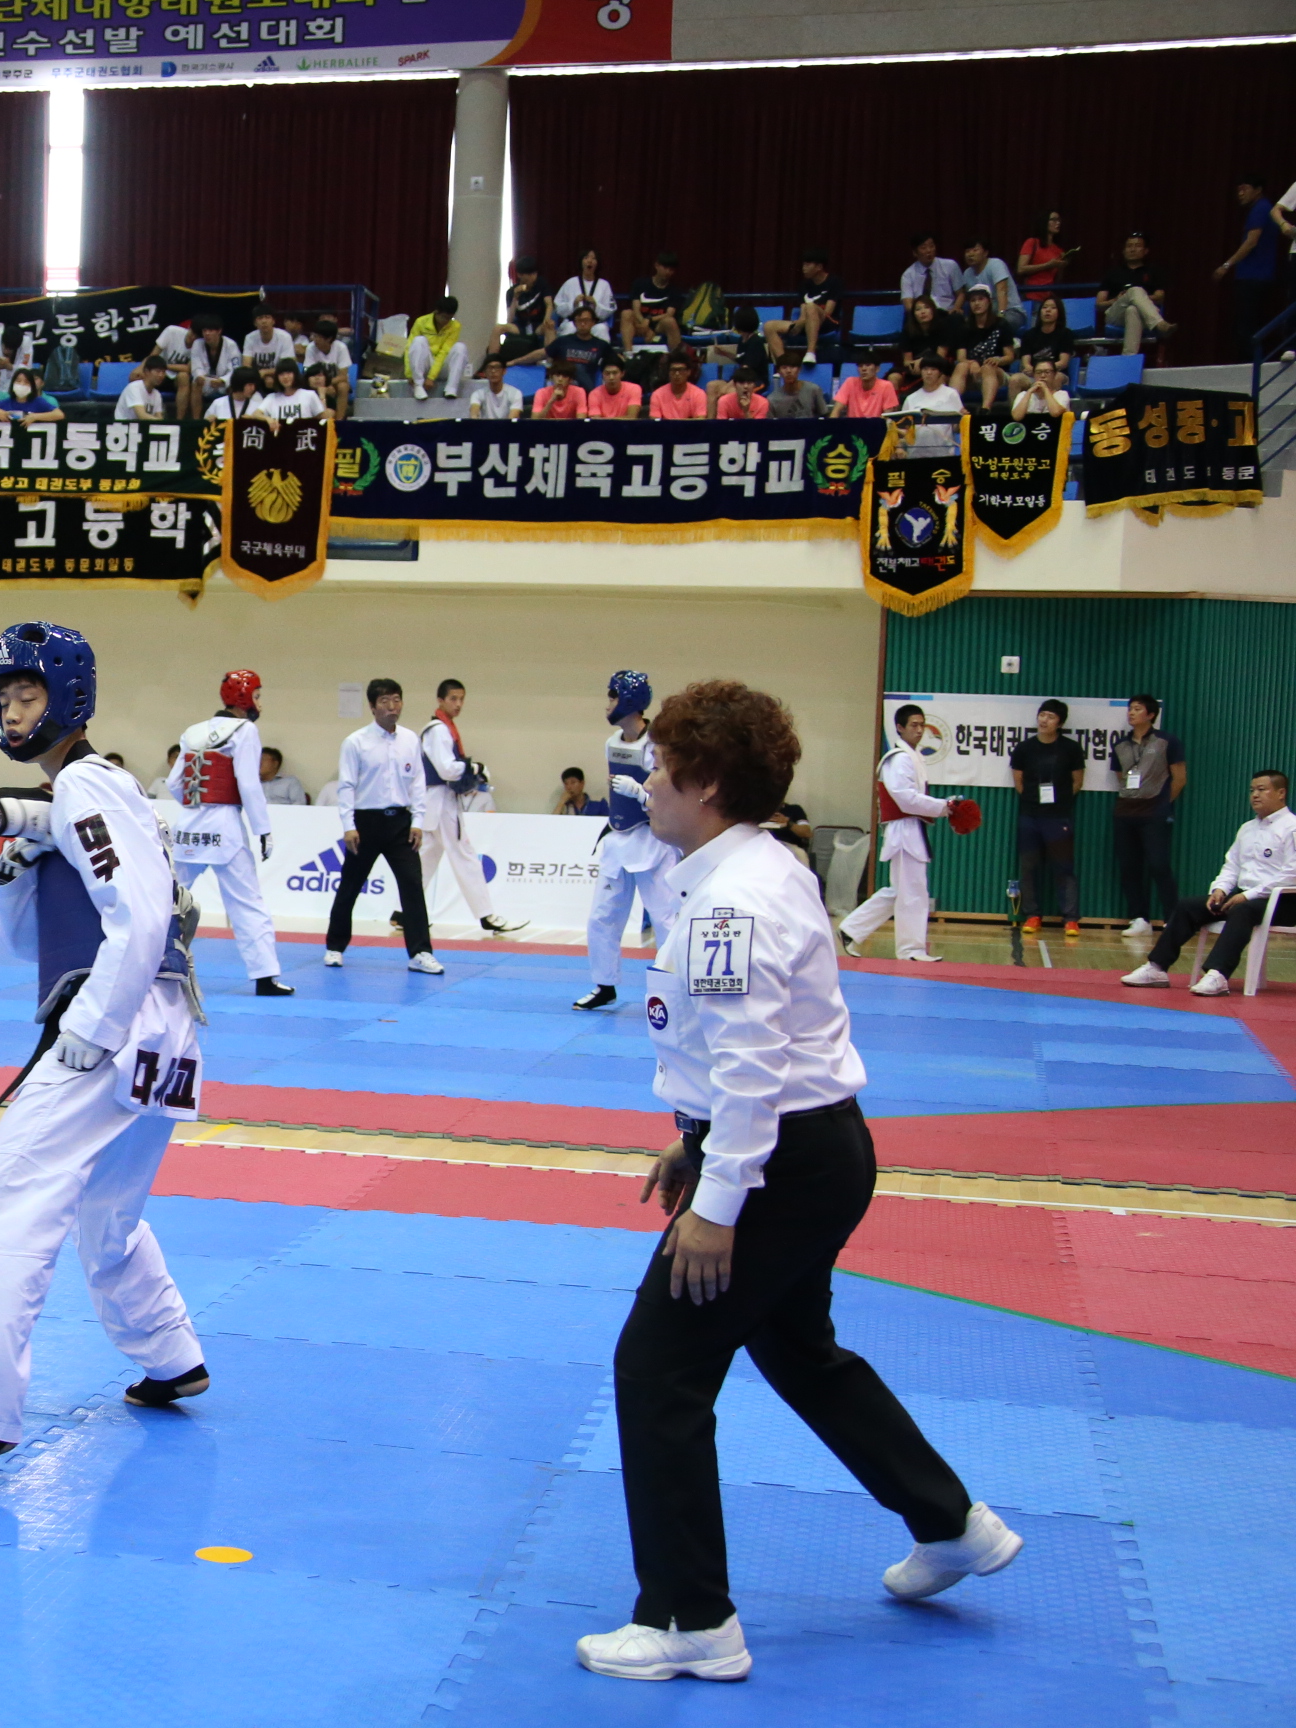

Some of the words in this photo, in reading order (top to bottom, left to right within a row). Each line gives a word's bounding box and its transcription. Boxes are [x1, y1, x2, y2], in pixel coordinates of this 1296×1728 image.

[163, 16, 344, 51] 예선대회
[313, 57, 379, 69] HERBALIFE
[398, 50, 430, 66] SPARK
[979, 423, 998, 442] 필
[1031, 422, 1052, 441] 승
[334, 447, 362, 478] 필
[433, 439, 806, 500] 부산체육고등학교
[823, 442, 850, 479] 승
[286, 871, 385, 895] adis
[704, 940, 735, 977] 71
[649, 1004, 666, 1020] KTA
